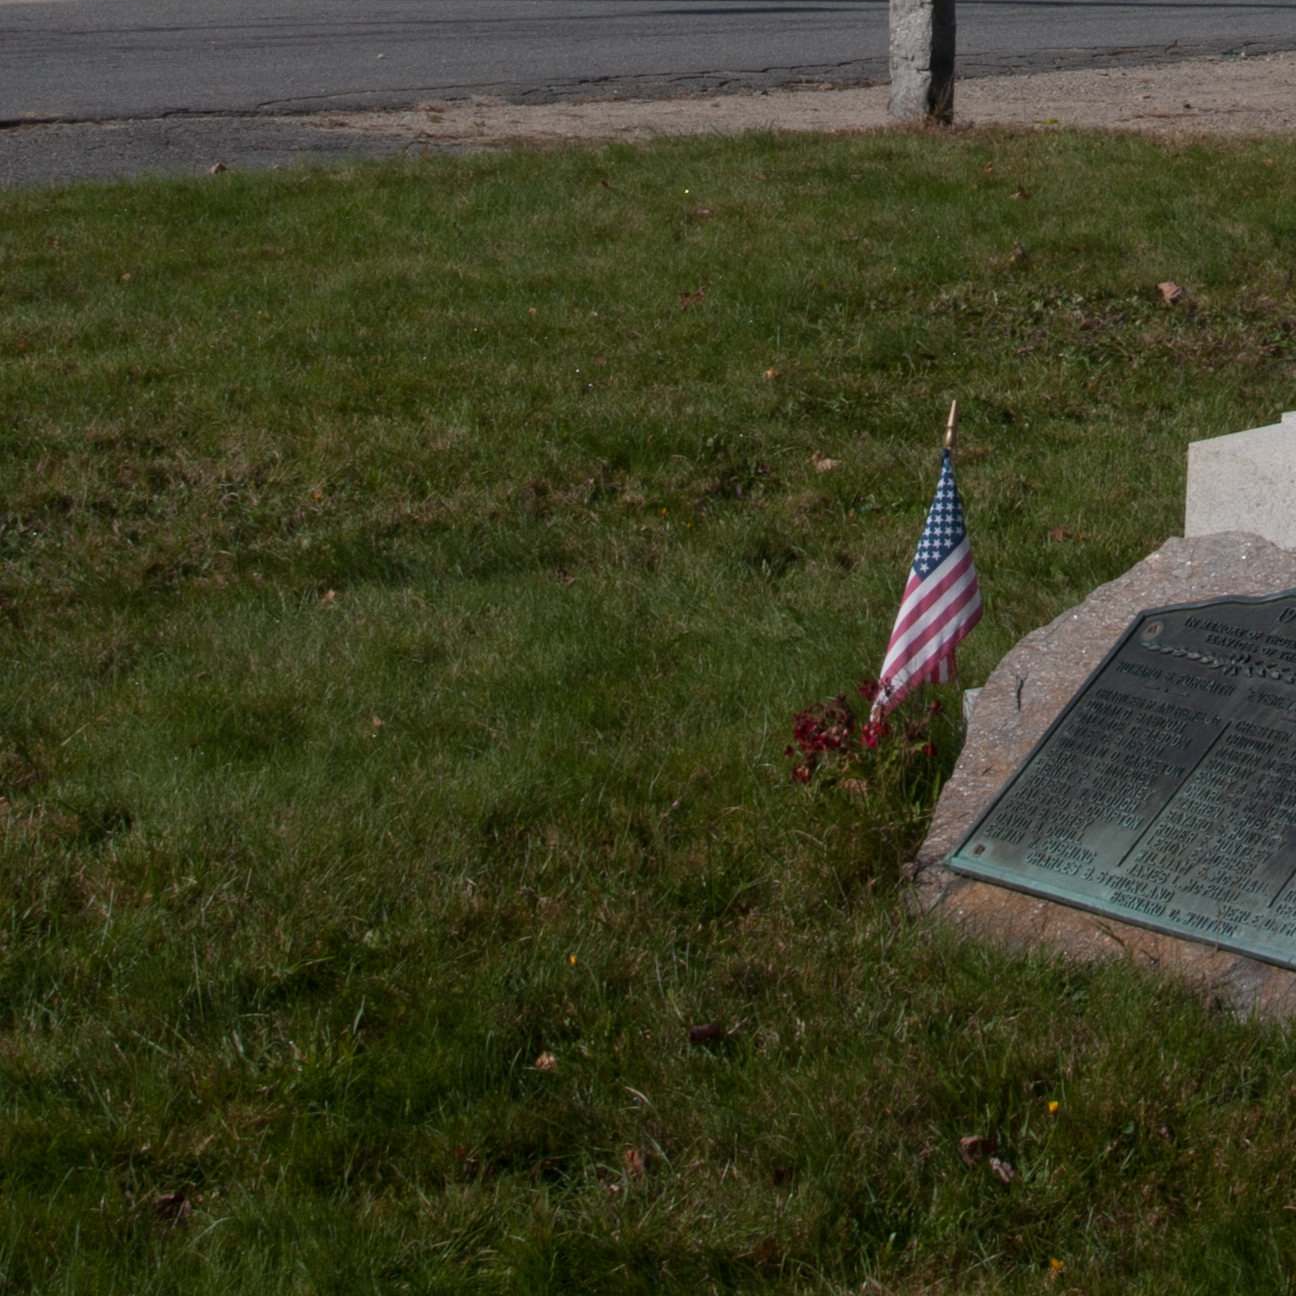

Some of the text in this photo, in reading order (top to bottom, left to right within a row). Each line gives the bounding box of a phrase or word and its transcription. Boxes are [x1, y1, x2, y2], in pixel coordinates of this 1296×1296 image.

[1185, 617, 1200, 626] IN
[1202, 620, 1247, 638] MEMORY
[1249, 631, 1264, 640] OF
[1205, 633, 1257, 653] SERVICES
[1260, 647, 1275, 657] OF
